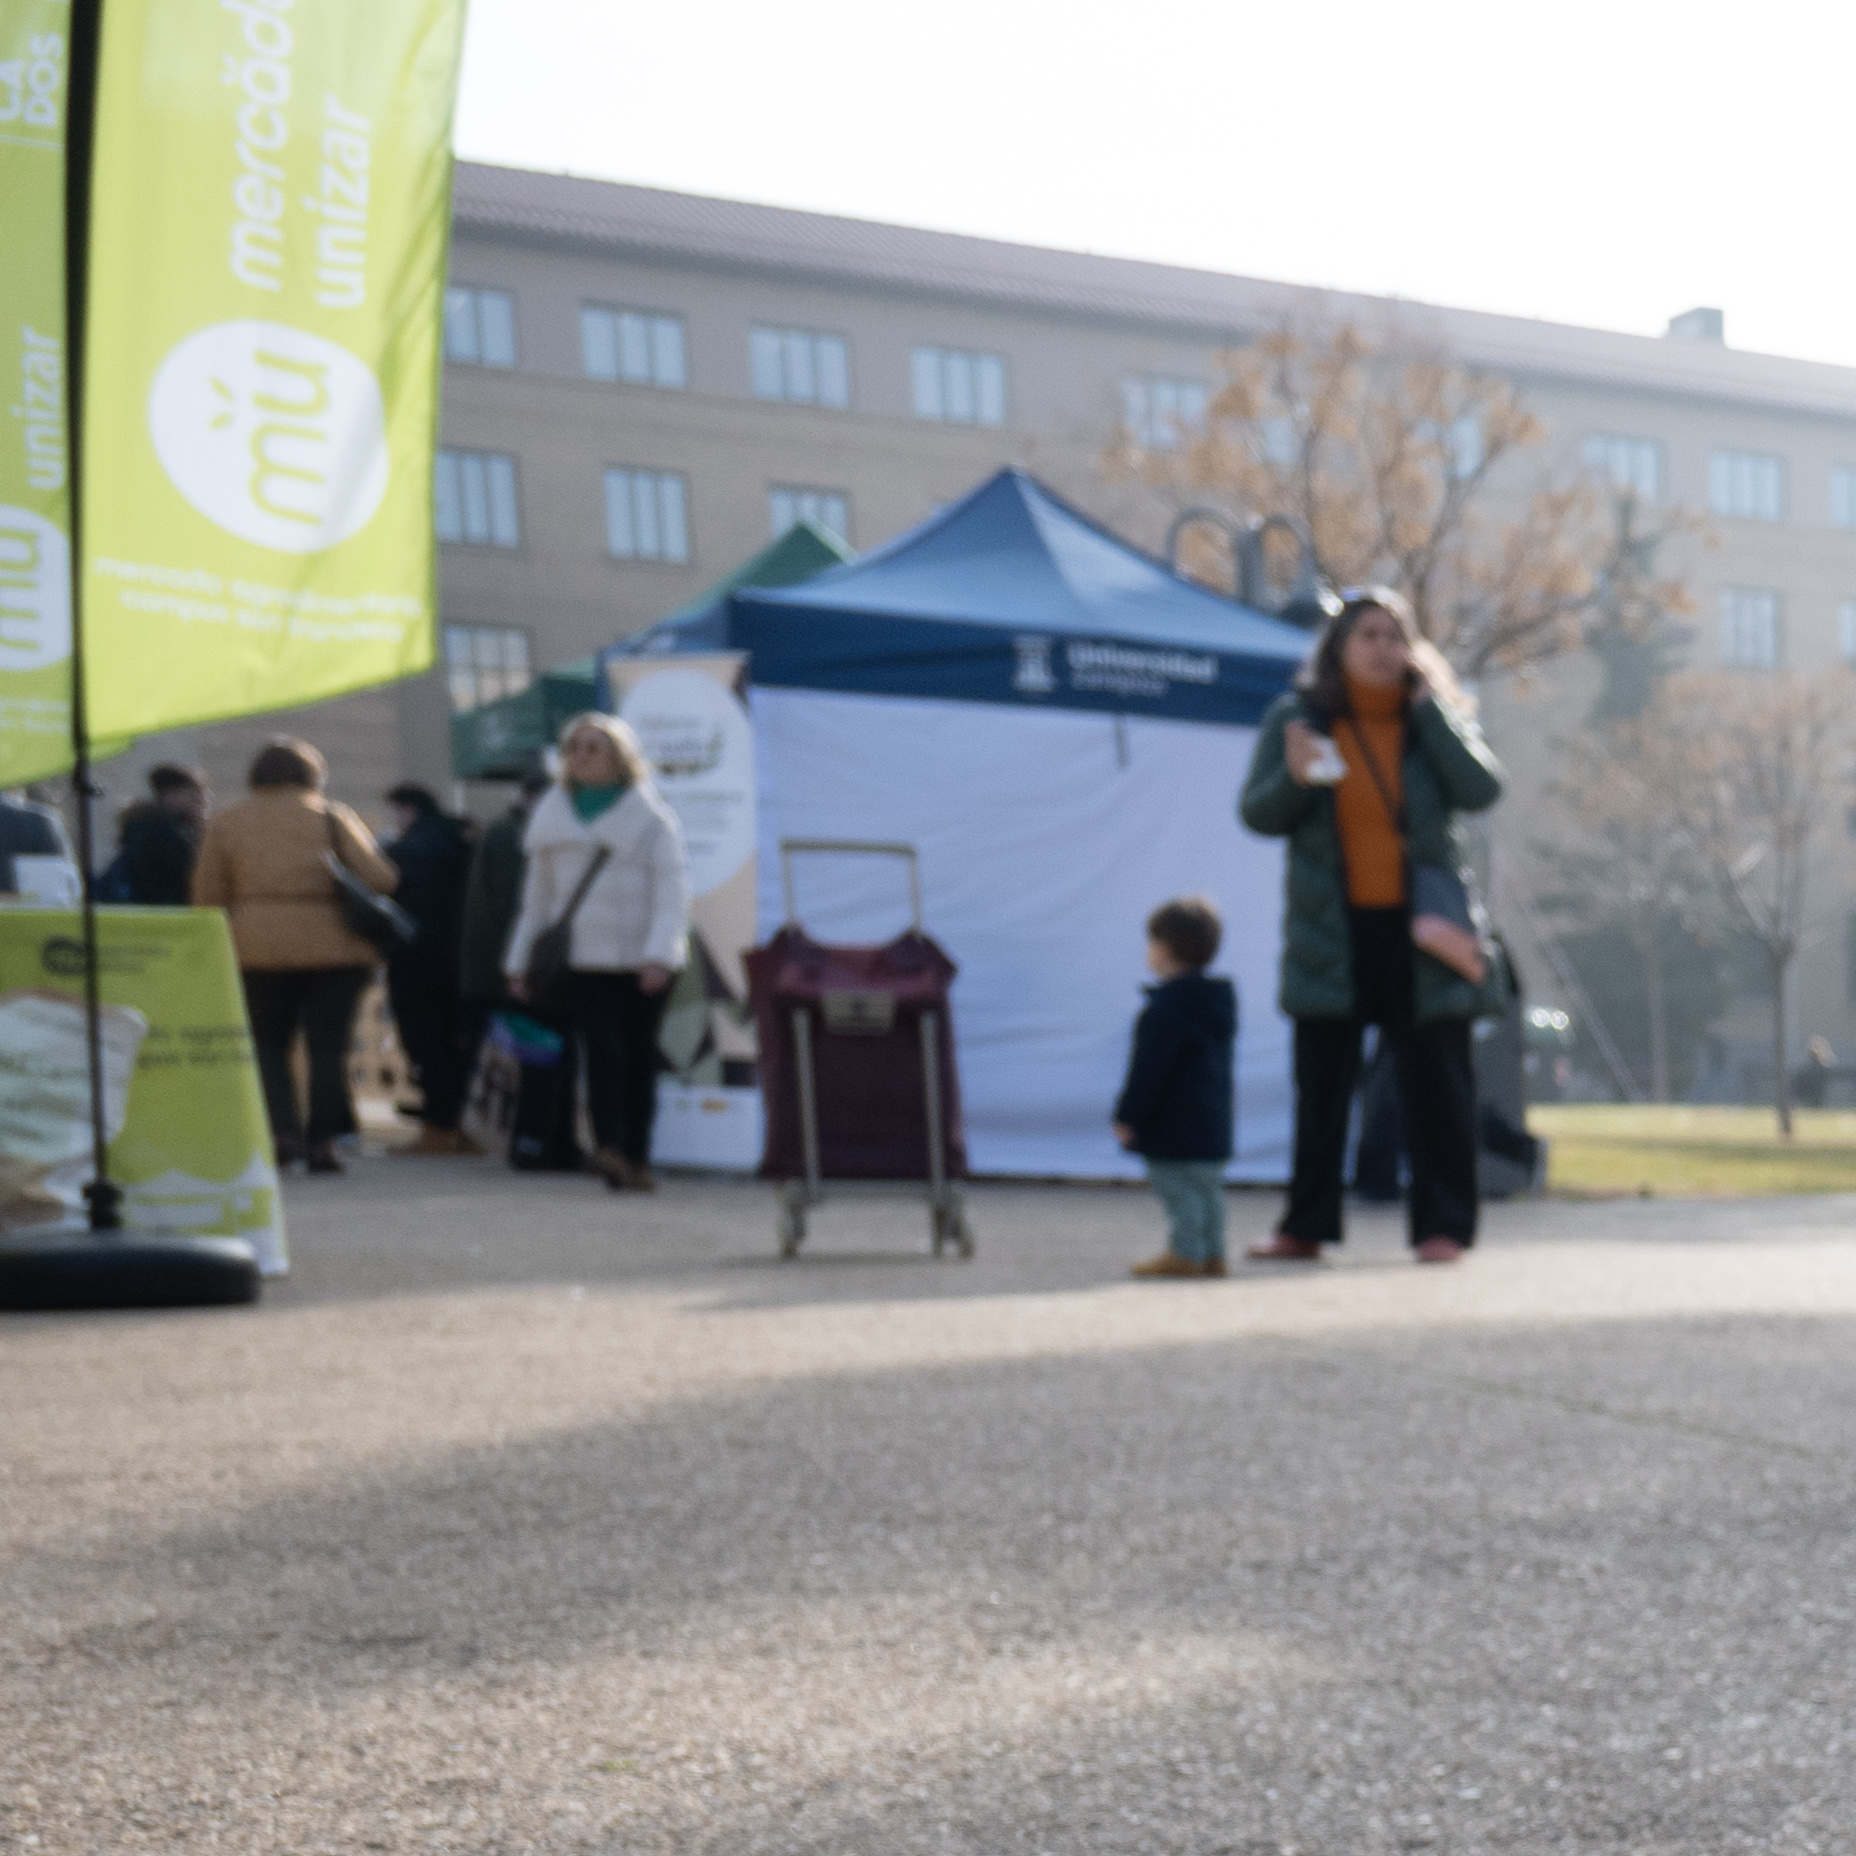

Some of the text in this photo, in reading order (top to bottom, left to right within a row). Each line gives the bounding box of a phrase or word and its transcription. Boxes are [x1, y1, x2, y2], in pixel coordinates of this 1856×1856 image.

[219, 0, 294, 293] mercad
[300, 92, 370, 308] unizar
[10, 324, 65, 490] unizar
